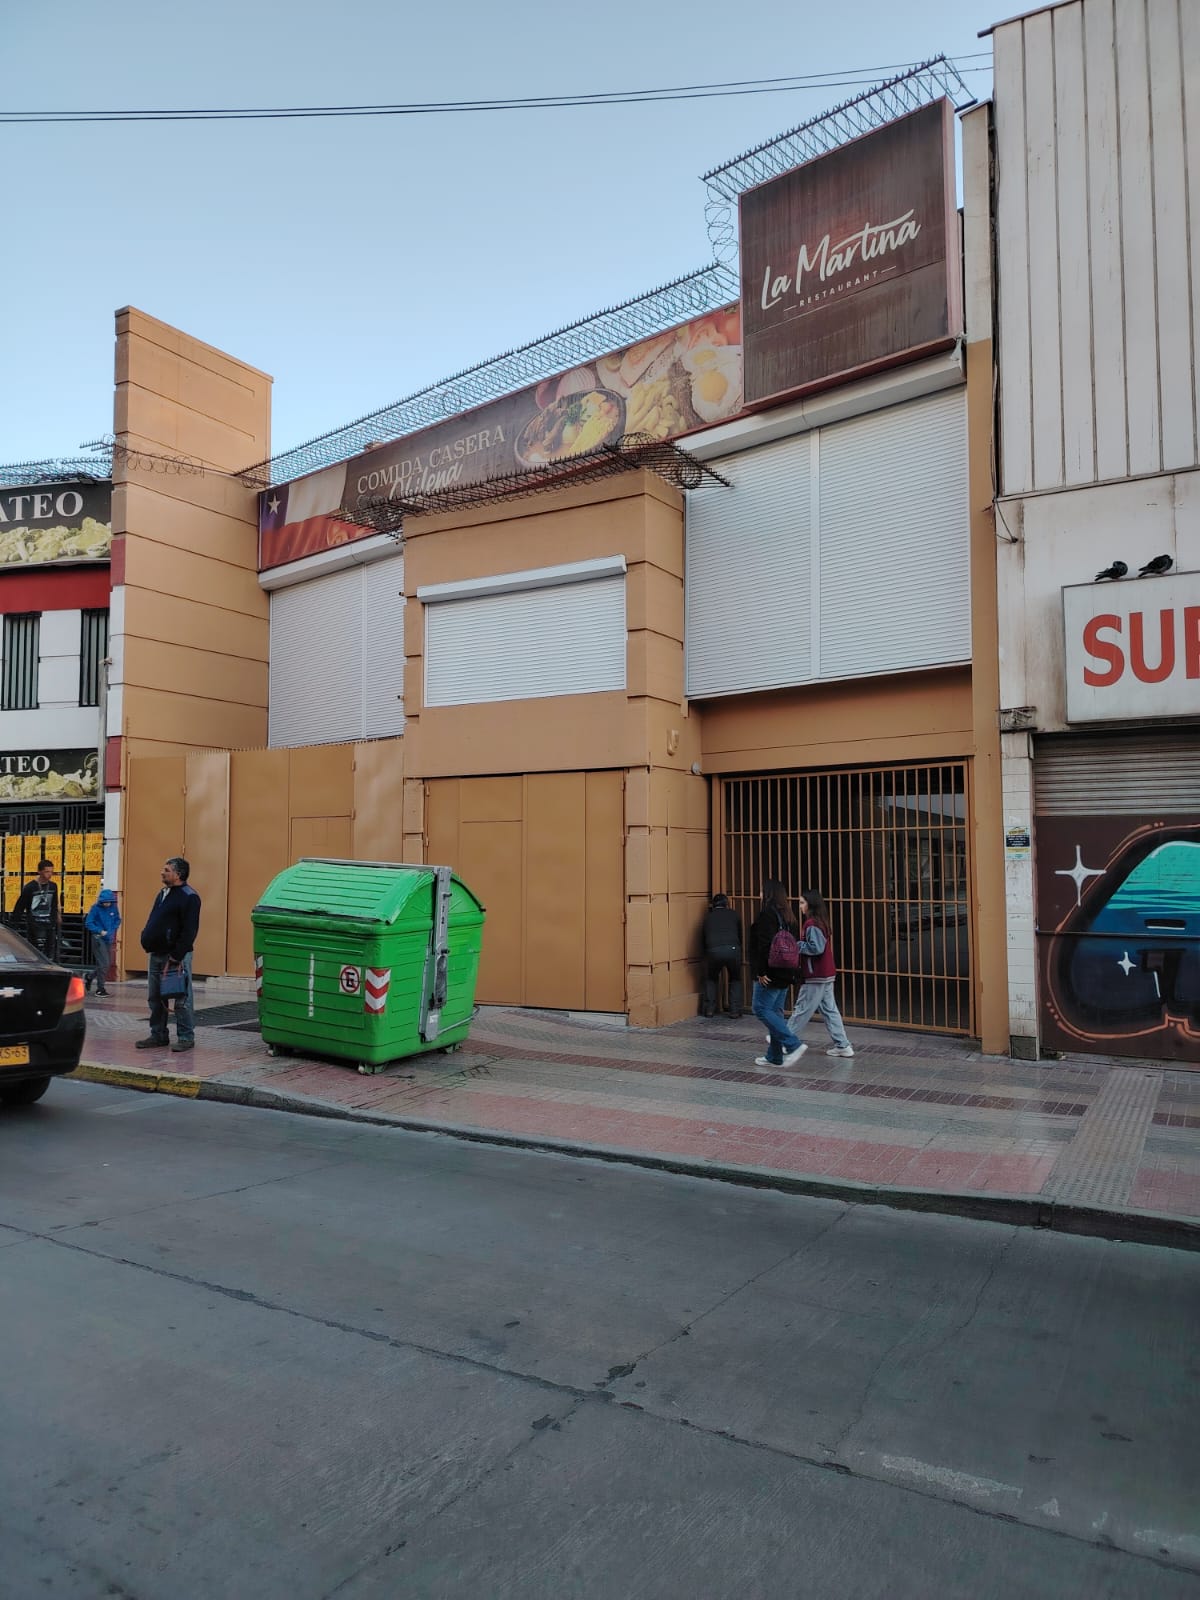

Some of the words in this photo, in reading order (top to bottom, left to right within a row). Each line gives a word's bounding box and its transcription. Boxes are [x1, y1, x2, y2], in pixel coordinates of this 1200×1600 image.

[760, 265, 794, 311] La
[795, 208, 922, 295] Martina
[799, 270, 879, 308] RESTAURANT
[356, 456, 424, 495] COMIDA
[428, 425, 507, 468] CASERA
